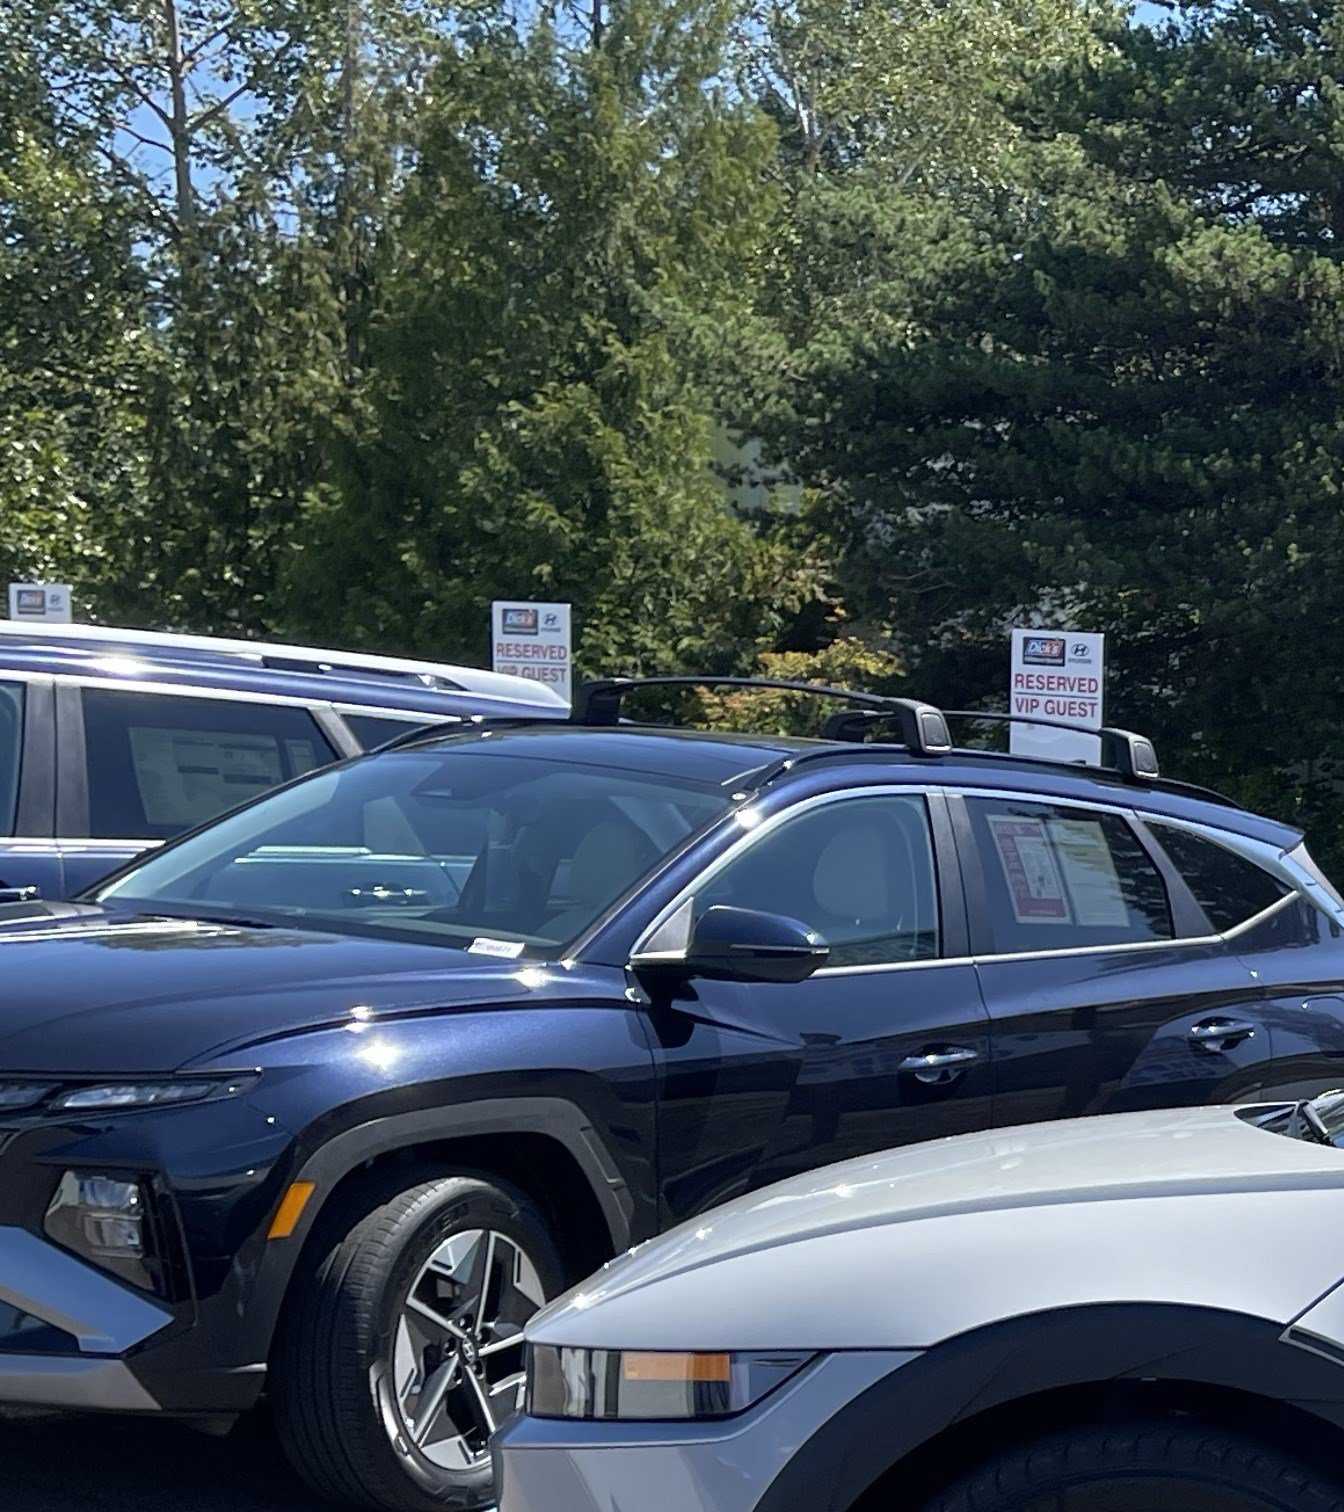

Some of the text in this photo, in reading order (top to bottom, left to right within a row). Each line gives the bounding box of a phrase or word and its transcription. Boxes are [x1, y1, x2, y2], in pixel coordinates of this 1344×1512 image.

[496, 643, 568, 660] RESERVED
[521, 666, 567, 683] GUEST
[1014, 673, 1099, 694] RESERVED
[1015, 697, 1098, 718] VIP GUEST
